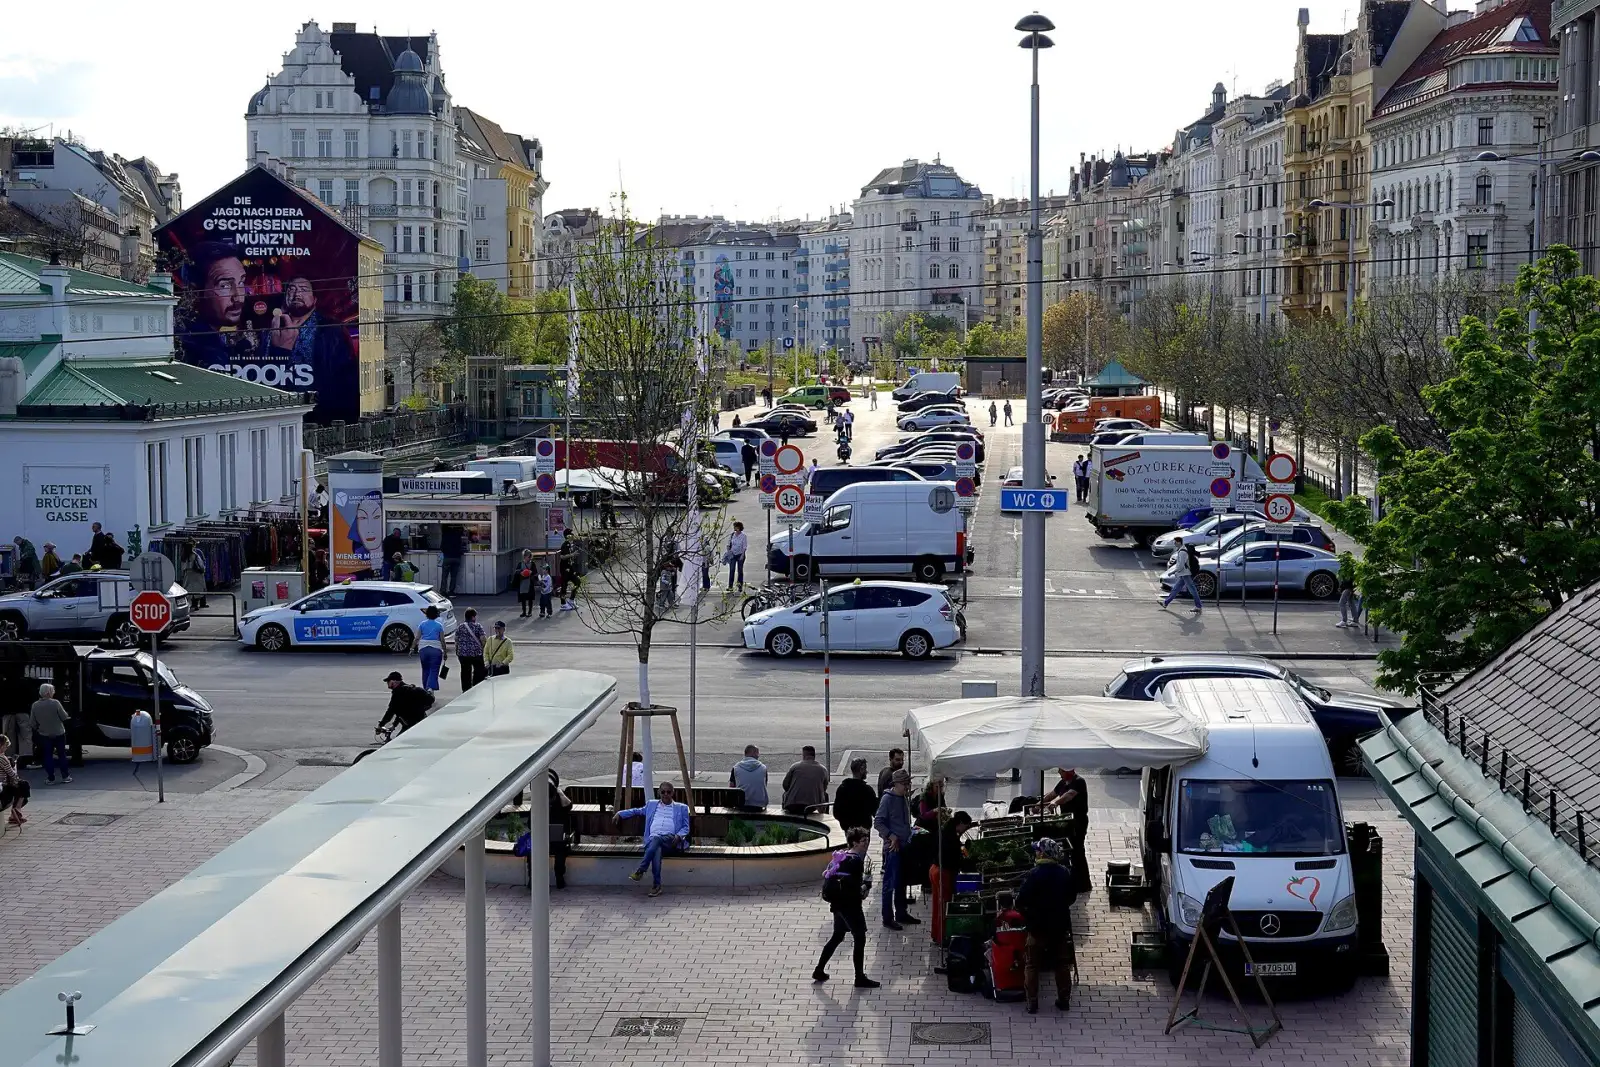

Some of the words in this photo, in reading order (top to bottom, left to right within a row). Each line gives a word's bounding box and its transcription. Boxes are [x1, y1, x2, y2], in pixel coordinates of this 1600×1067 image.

[233, 196, 252, 205] DIE
[212, 207, 241, 216] JAGD
[242, 207, 273, 216] NACH
[274, 207, 304, 217] DERA
[203, 218, 312, 231] G'SCHISSENEN
[235, 230, 295, 245] MÜNZ'N
[245, 247, 274, 256] GEHT
[275, 247, 311, 256] WEIDA
[1127, 460, 1186, 477] ÖZYÜREK
[401, 479, 460, 491] WÜRSTELINSEL
[1143, 477, 1160, 485] Obst
[1168, 477, 1197, 485] Gemüse
[40, 484, 93, 496] KETTEN
[1185, 487, 1202, 495] Stand
[35, 496, 98, 509] BRÜCKEN
[1012, 493, 1036, 507] WC
[1270, 501, 1289, 516] 3,5t
[46, 511, 89, 522] GASSE
[134, 603, 168, 620] STOP
